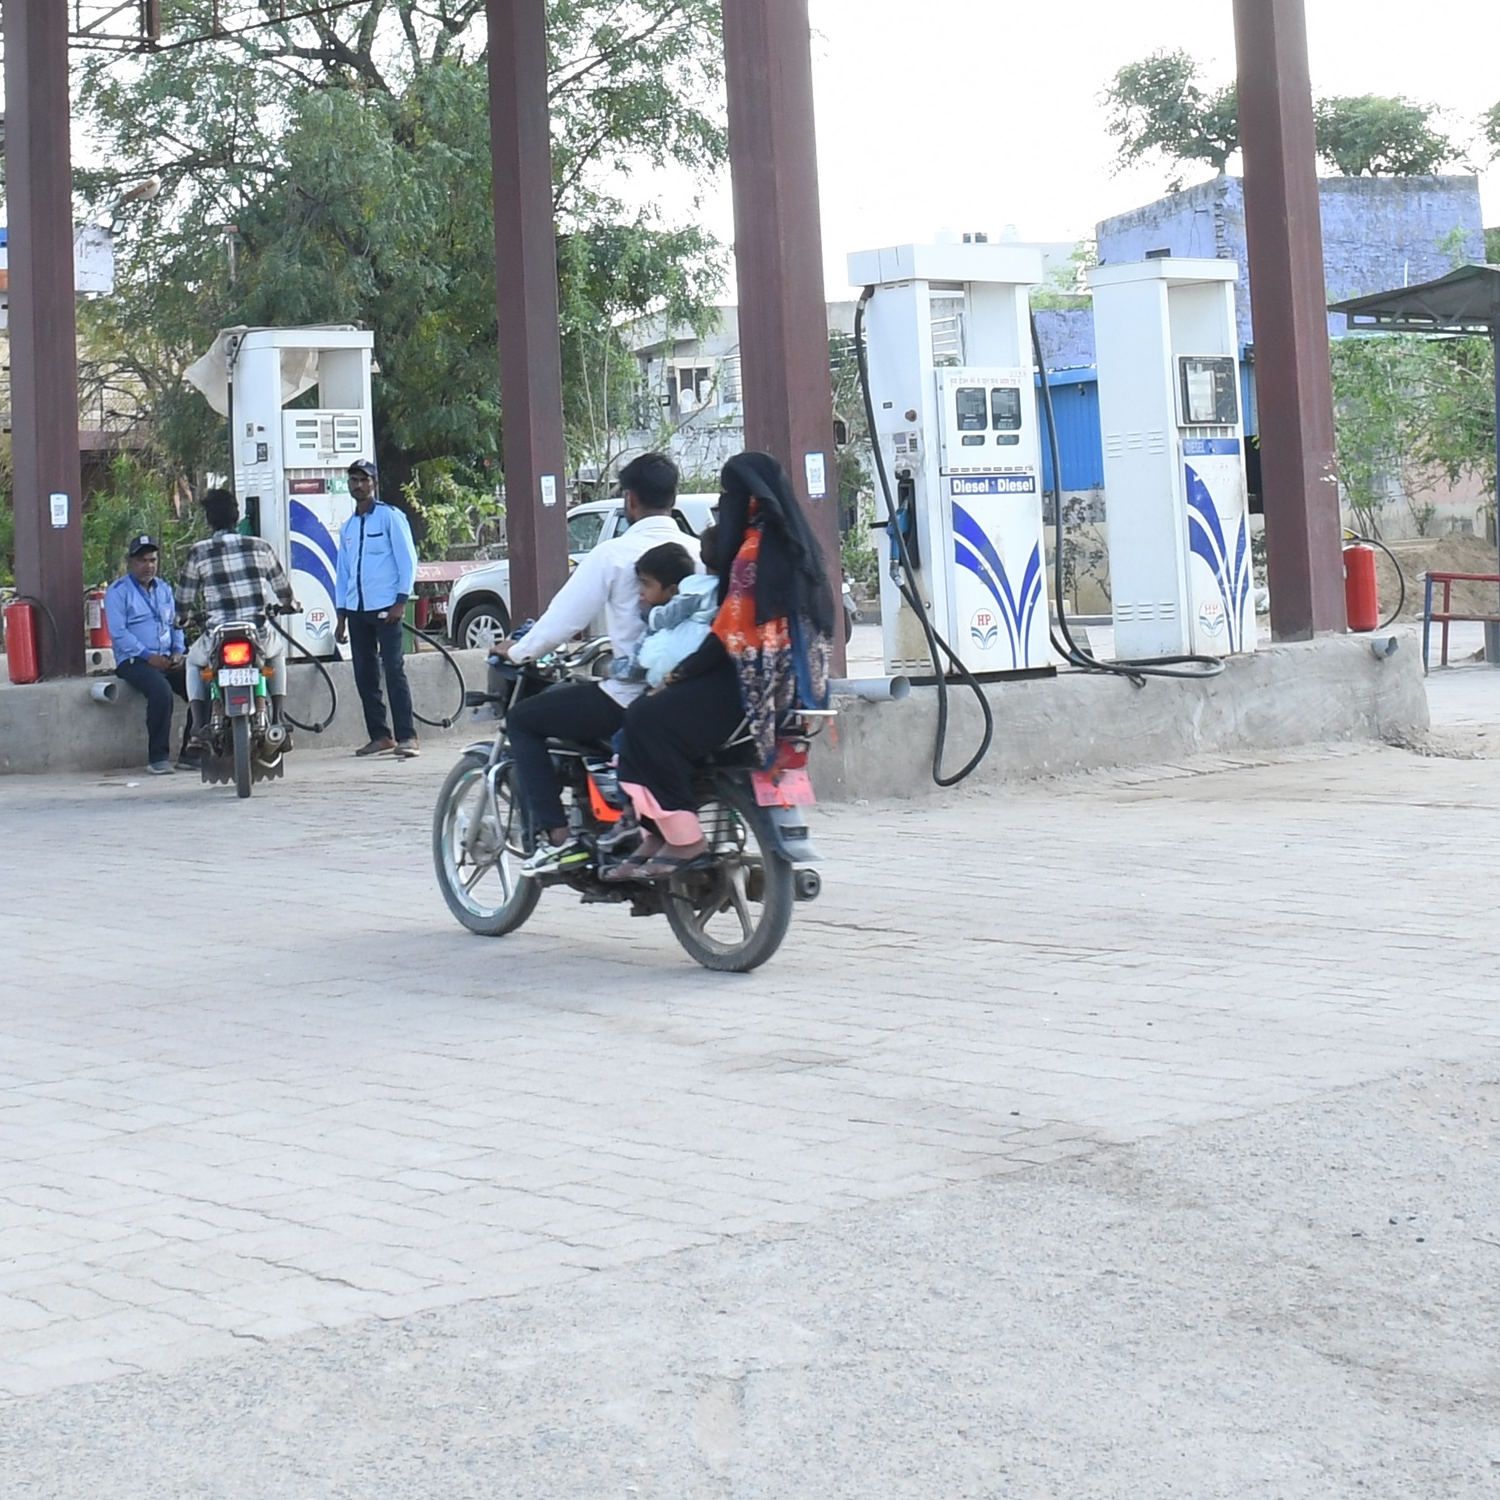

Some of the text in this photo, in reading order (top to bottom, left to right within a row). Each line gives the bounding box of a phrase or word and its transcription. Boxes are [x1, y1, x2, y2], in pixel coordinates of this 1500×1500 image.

[952, 477, 1034, 493] Diesel Diesel
[1204, 604, 1219, 615] HP
[311, 612, 325, 622] HP
[977, 614, 992, 626] HP
